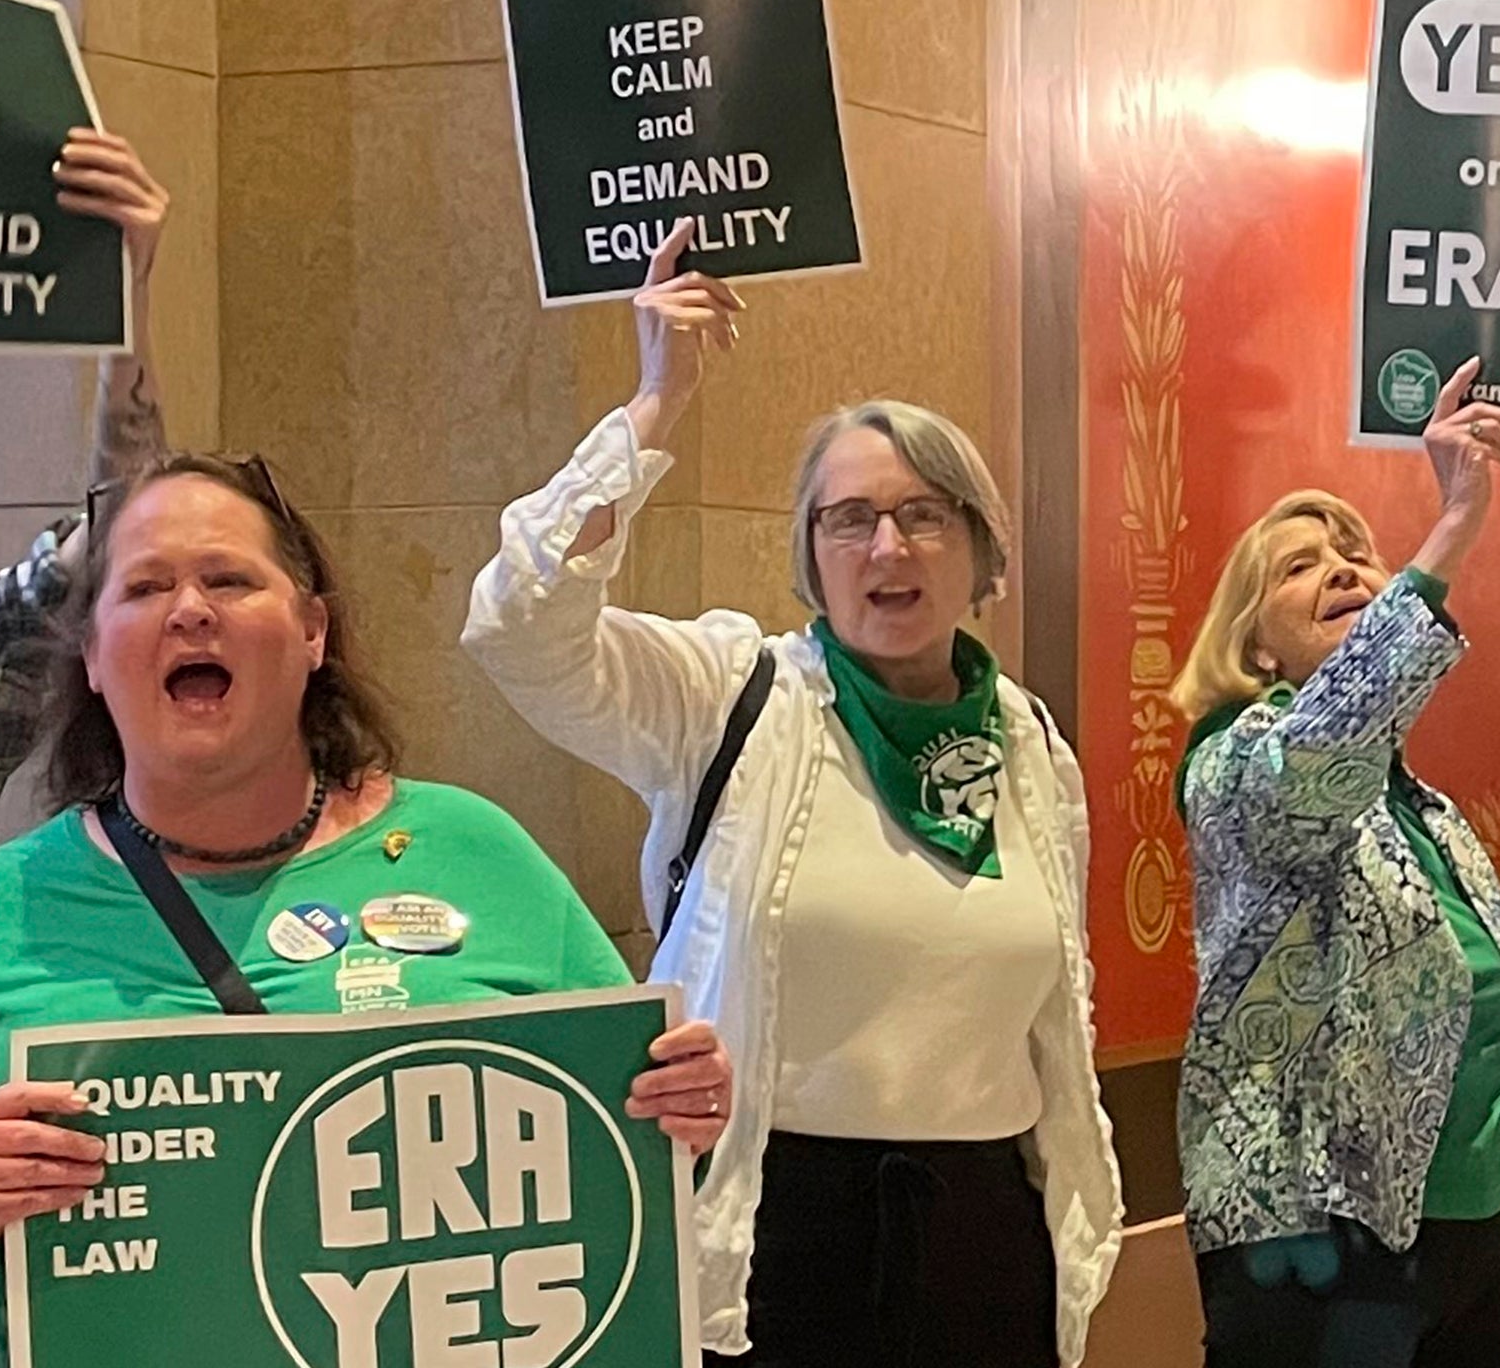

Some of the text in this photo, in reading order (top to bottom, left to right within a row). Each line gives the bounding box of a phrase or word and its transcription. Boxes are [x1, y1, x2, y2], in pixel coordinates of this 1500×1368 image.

[608, 15, 704, 59] KEEP
[611, 56, 713, 99] CALM
[637, 107, 695, 141] and
[590, 152, 770, 207] DEMAND
[73, 1070, 282, 1117] QUALITY
[314, 1062, 572, 1249] ERA
[52, 1238, 159, 1278] LAW
